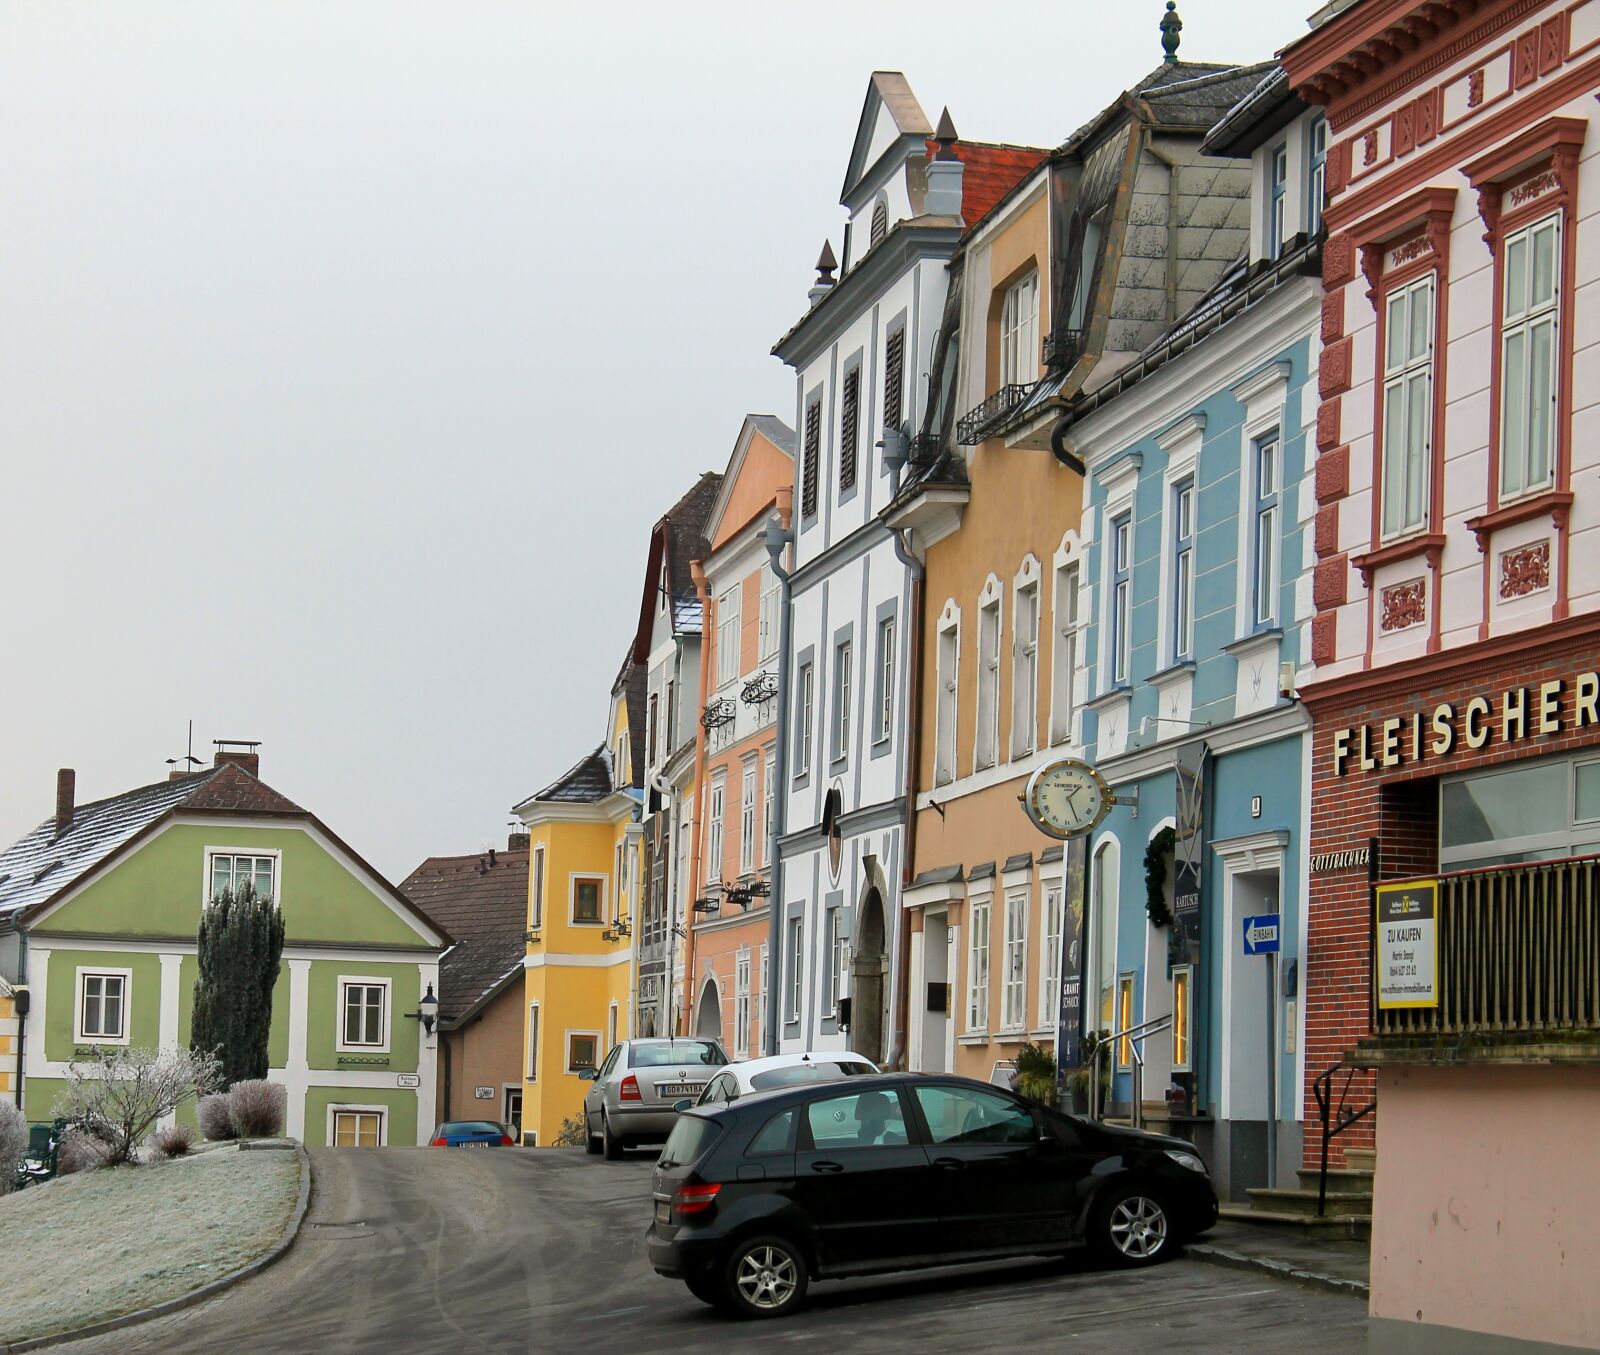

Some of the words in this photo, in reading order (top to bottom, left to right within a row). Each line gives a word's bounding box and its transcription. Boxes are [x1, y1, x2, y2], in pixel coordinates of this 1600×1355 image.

[1253, 927, 1274, 941] EINBAHN
[1387, 929, 1396, 943] ZU
[1397, 927, 1421, 942] KAUFEN
[1063, 983, 1080, 995] GRANIT
